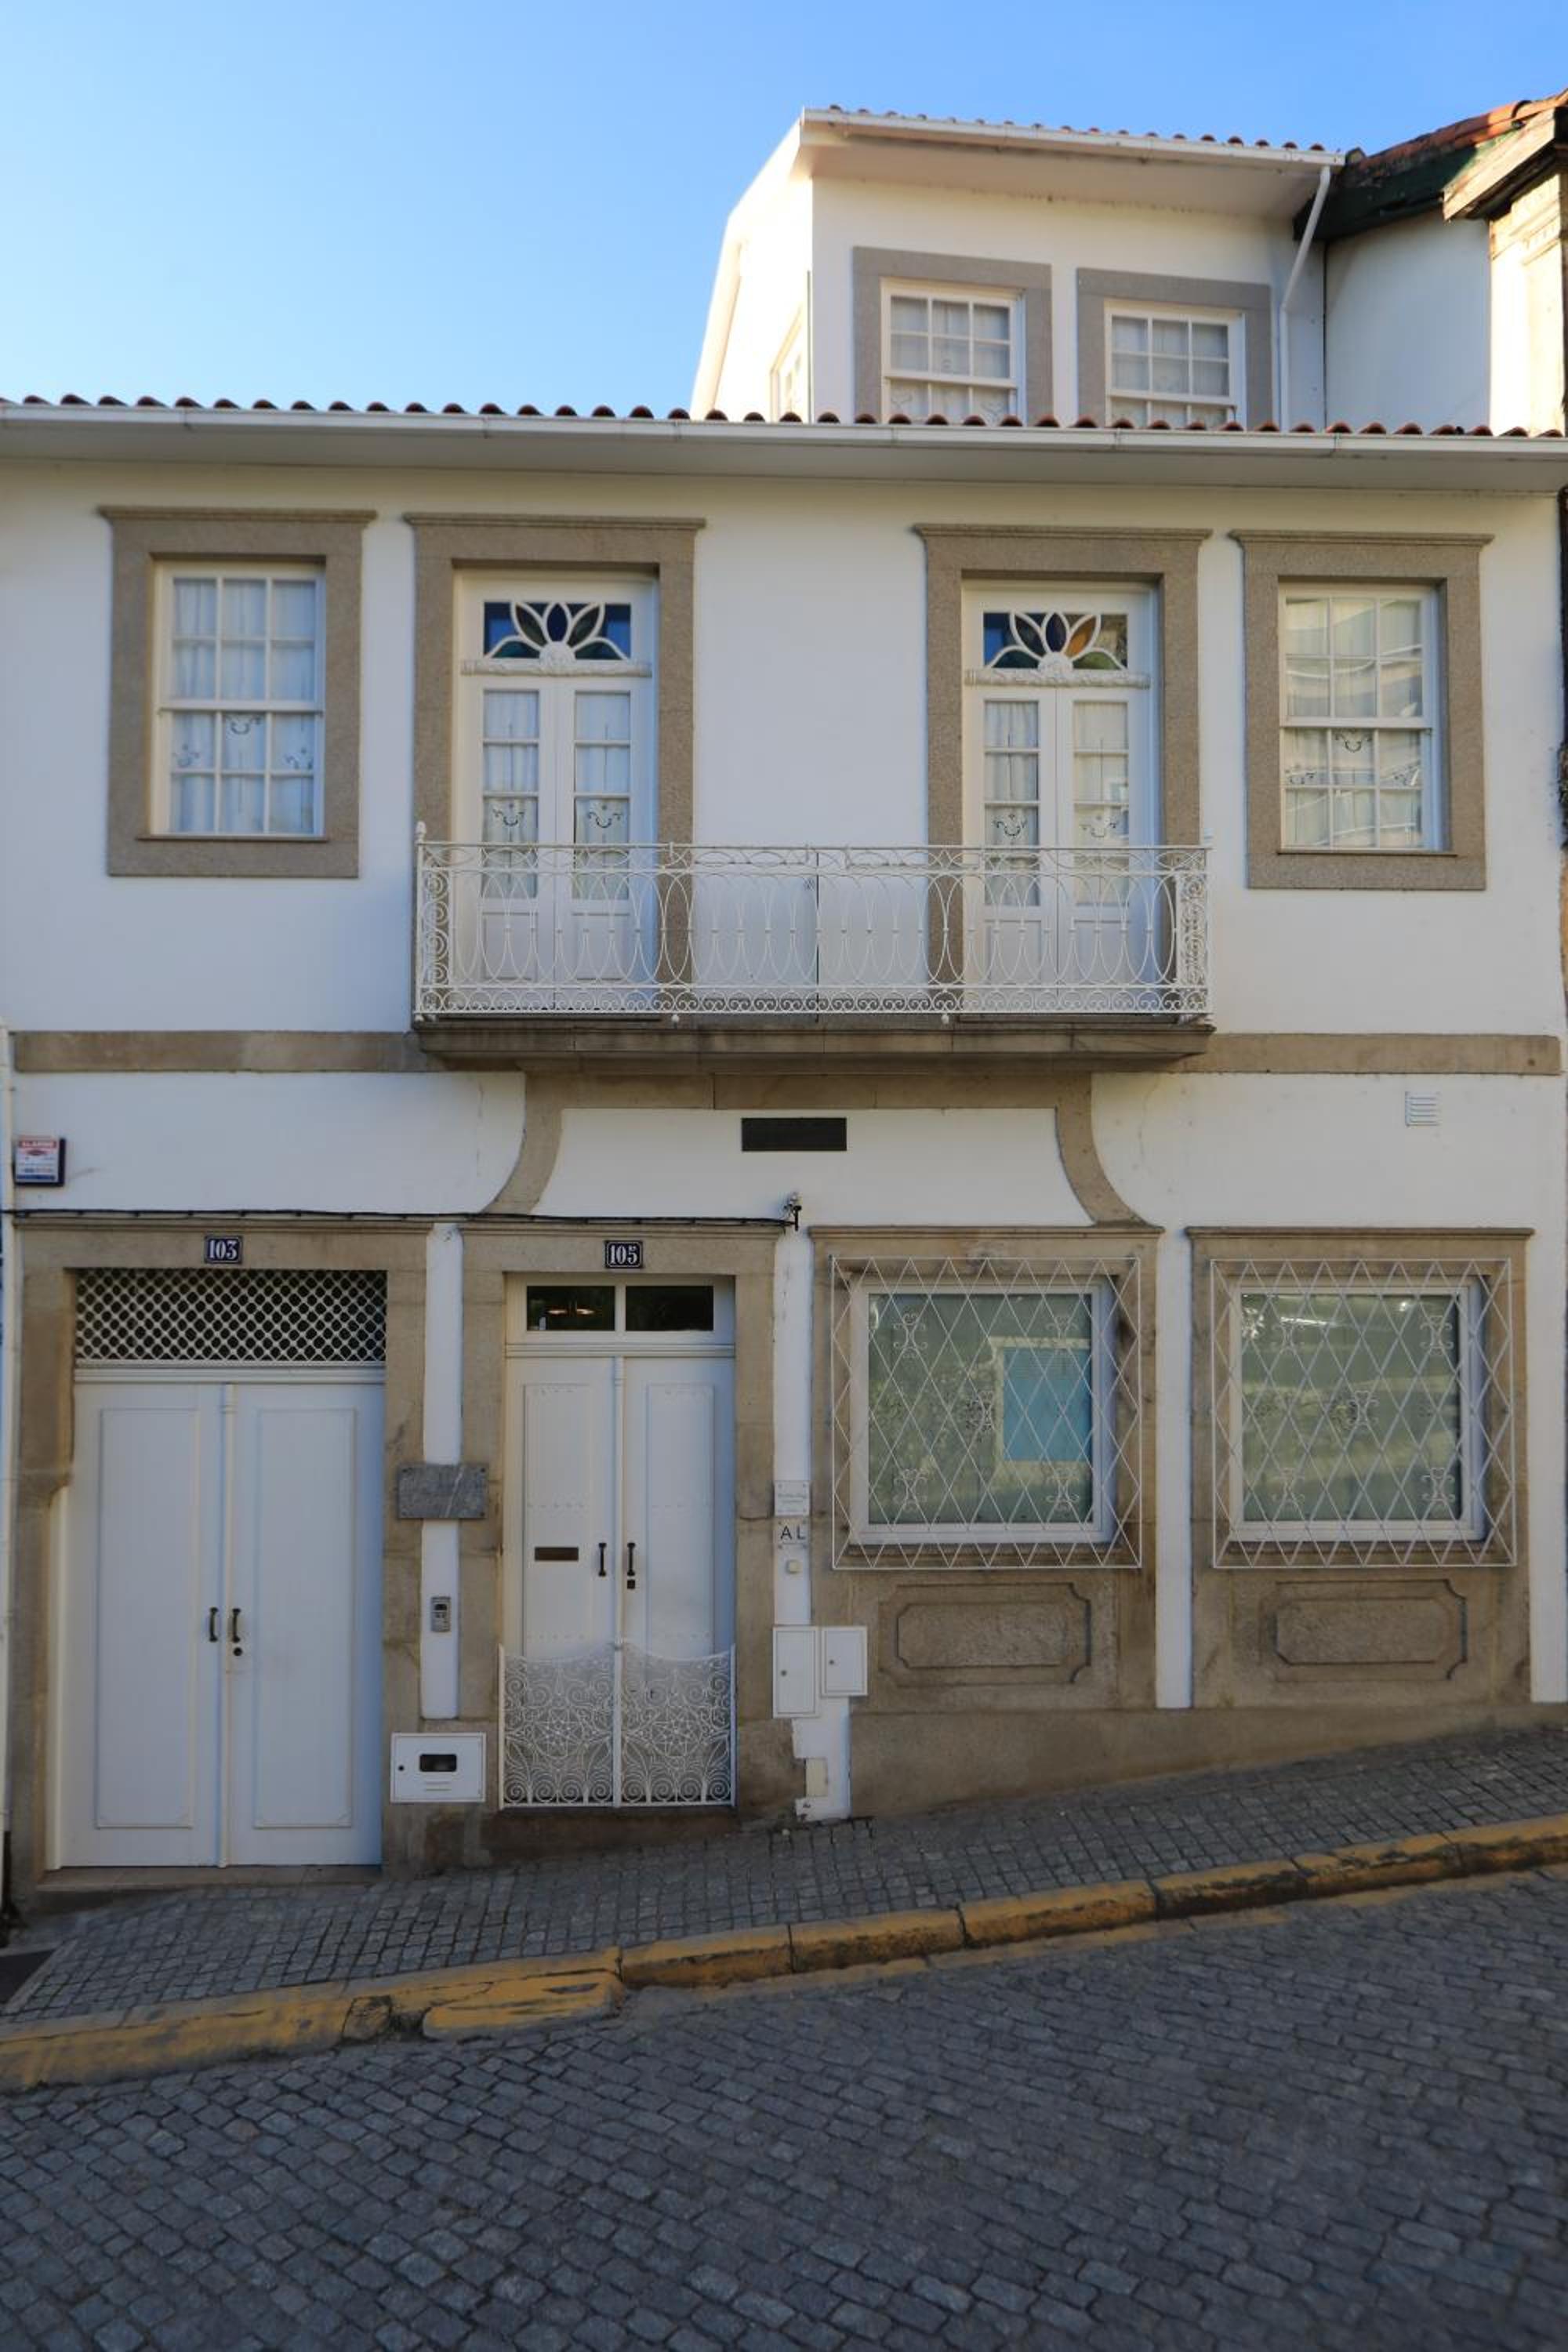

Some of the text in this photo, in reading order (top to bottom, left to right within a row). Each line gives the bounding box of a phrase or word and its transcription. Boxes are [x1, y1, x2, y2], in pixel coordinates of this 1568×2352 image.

[209, 1240, 238, 1260] 103
[611, 1244, 637, 1265] 105
[780, 1525, 807, 1541] AL
